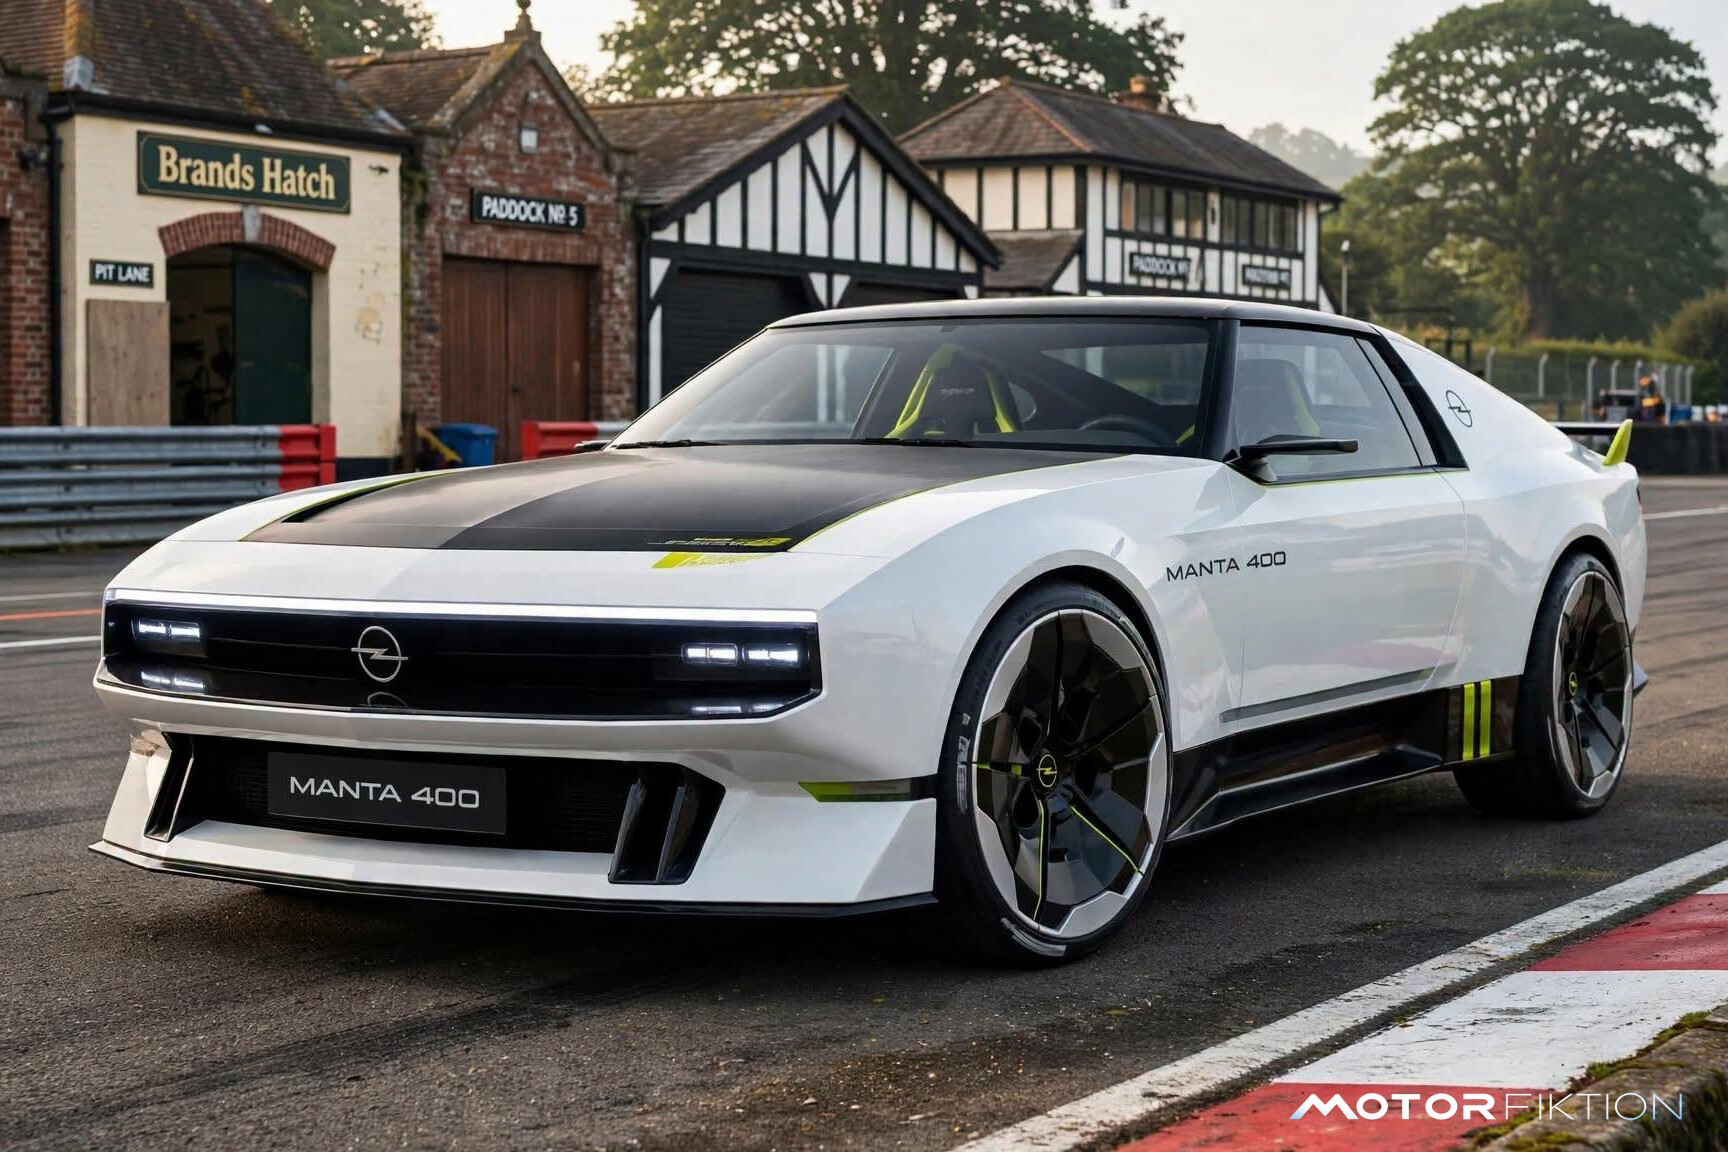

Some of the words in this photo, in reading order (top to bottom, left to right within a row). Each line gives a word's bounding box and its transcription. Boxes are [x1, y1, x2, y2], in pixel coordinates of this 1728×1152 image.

[157, 145, 255, 192] Brands
[261, 157, 336, 200] Hatch
[481, 195, 546, 223] PADDOCK
[568, 205, 579, 227] 5
[95, 263, 114, 281] PIT
[117, 265, 150, 283] LANE
[1166, 557, 1240, 582] MANTA
[1246, 550, 1287, 569] 400
[290, 776, 402, 803] MANTA
[410, 786, 480, 809] 400
